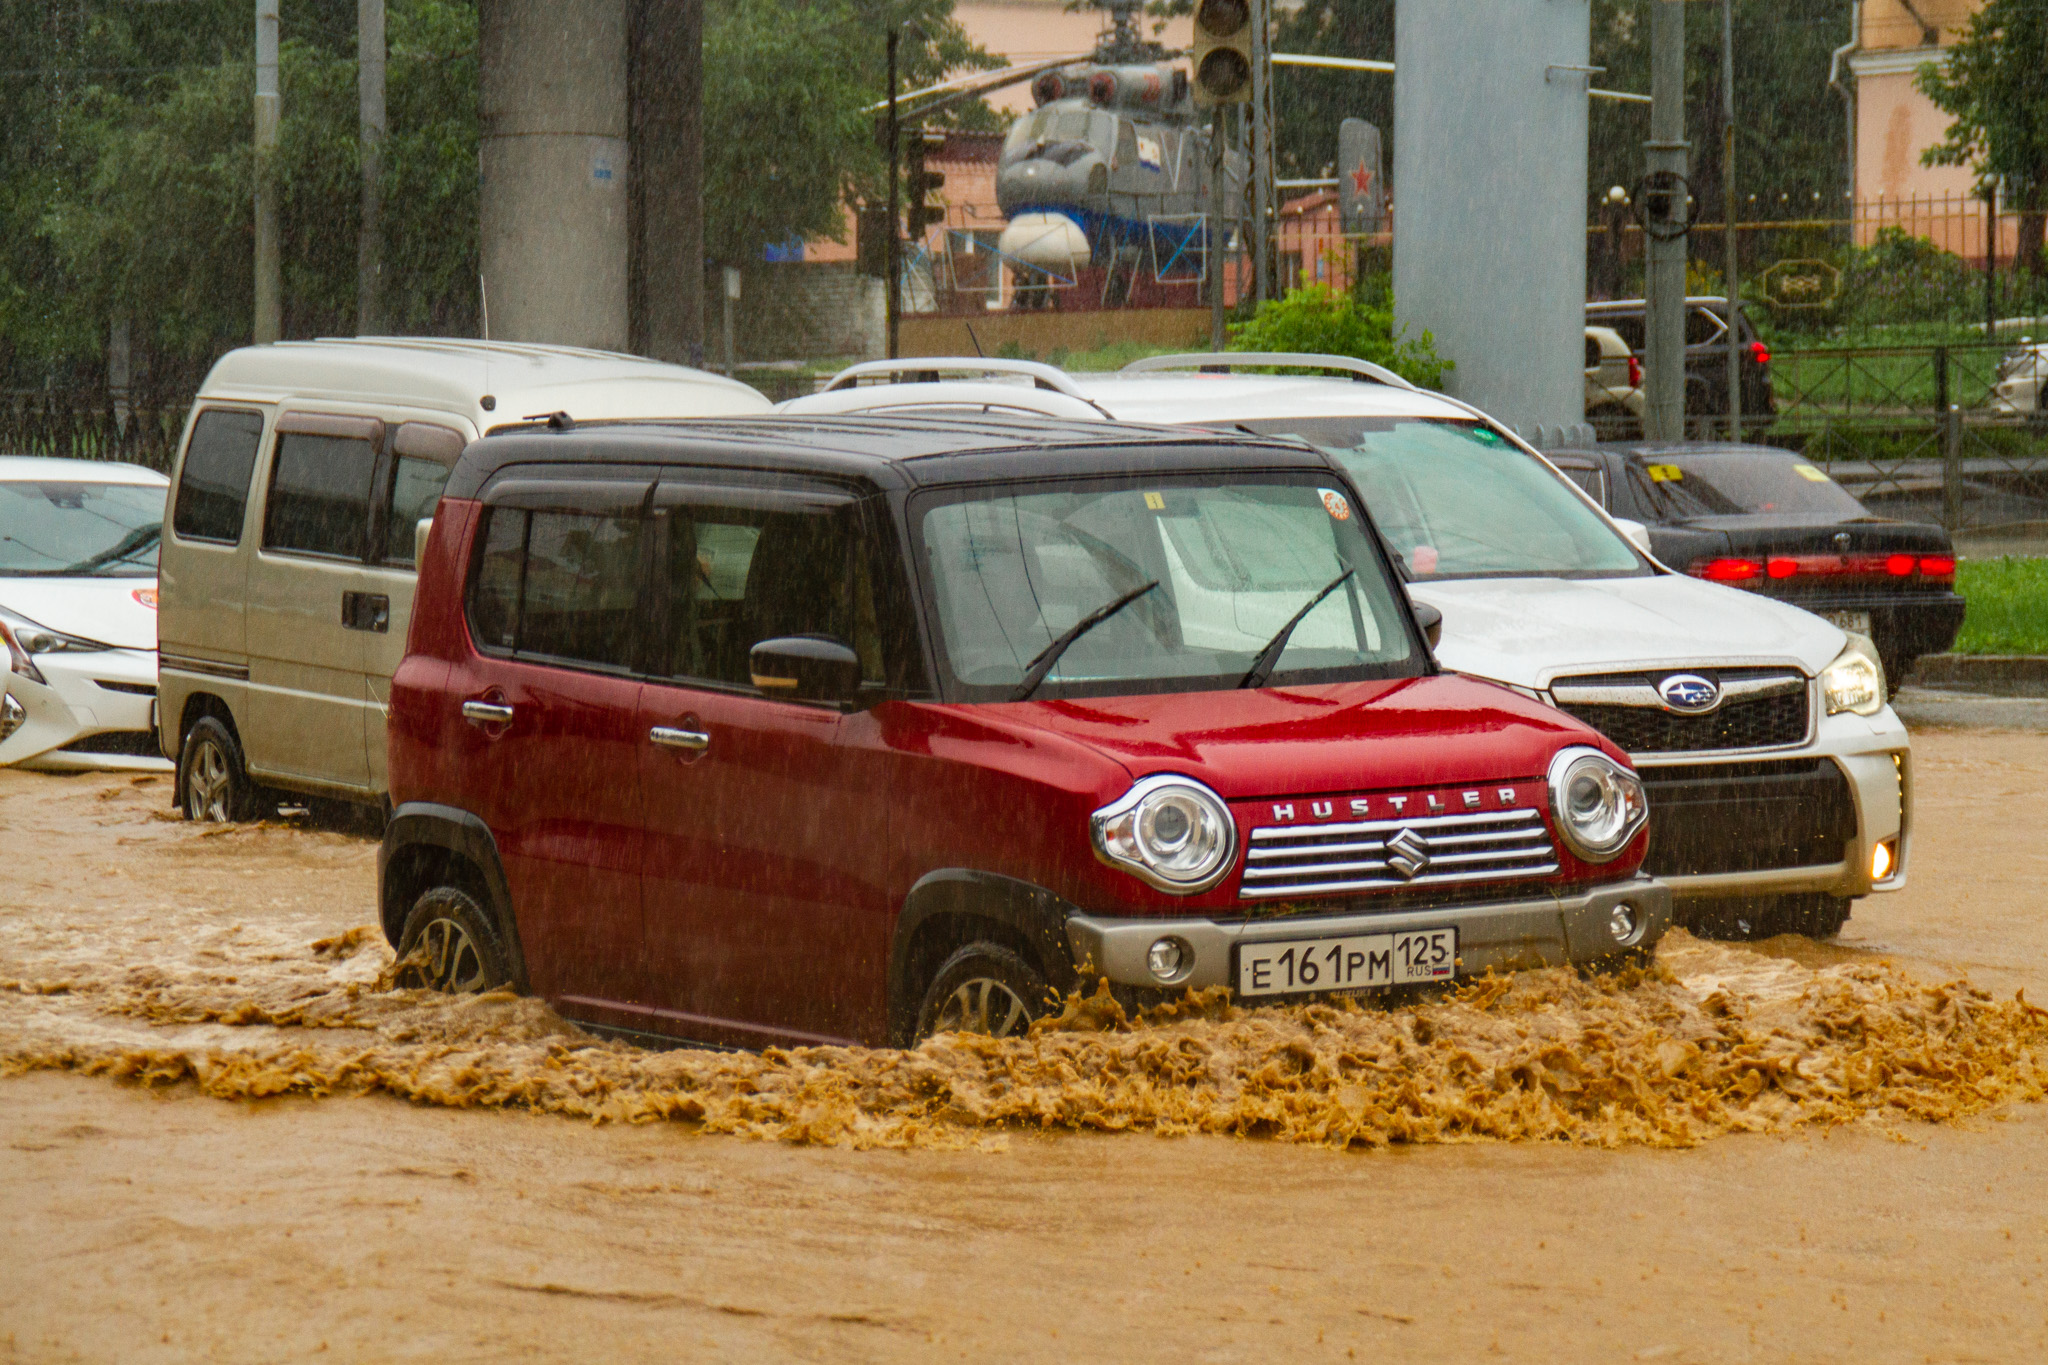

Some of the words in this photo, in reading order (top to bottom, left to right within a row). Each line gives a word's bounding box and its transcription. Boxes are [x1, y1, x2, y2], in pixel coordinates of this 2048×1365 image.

[1273, 788, 1516, 821] HUSTLER
[1252, 945, 1391, 989] E161PM
[1398, 934, 1447, 966] 125
[1406, 965, 1432, 977] RUS
